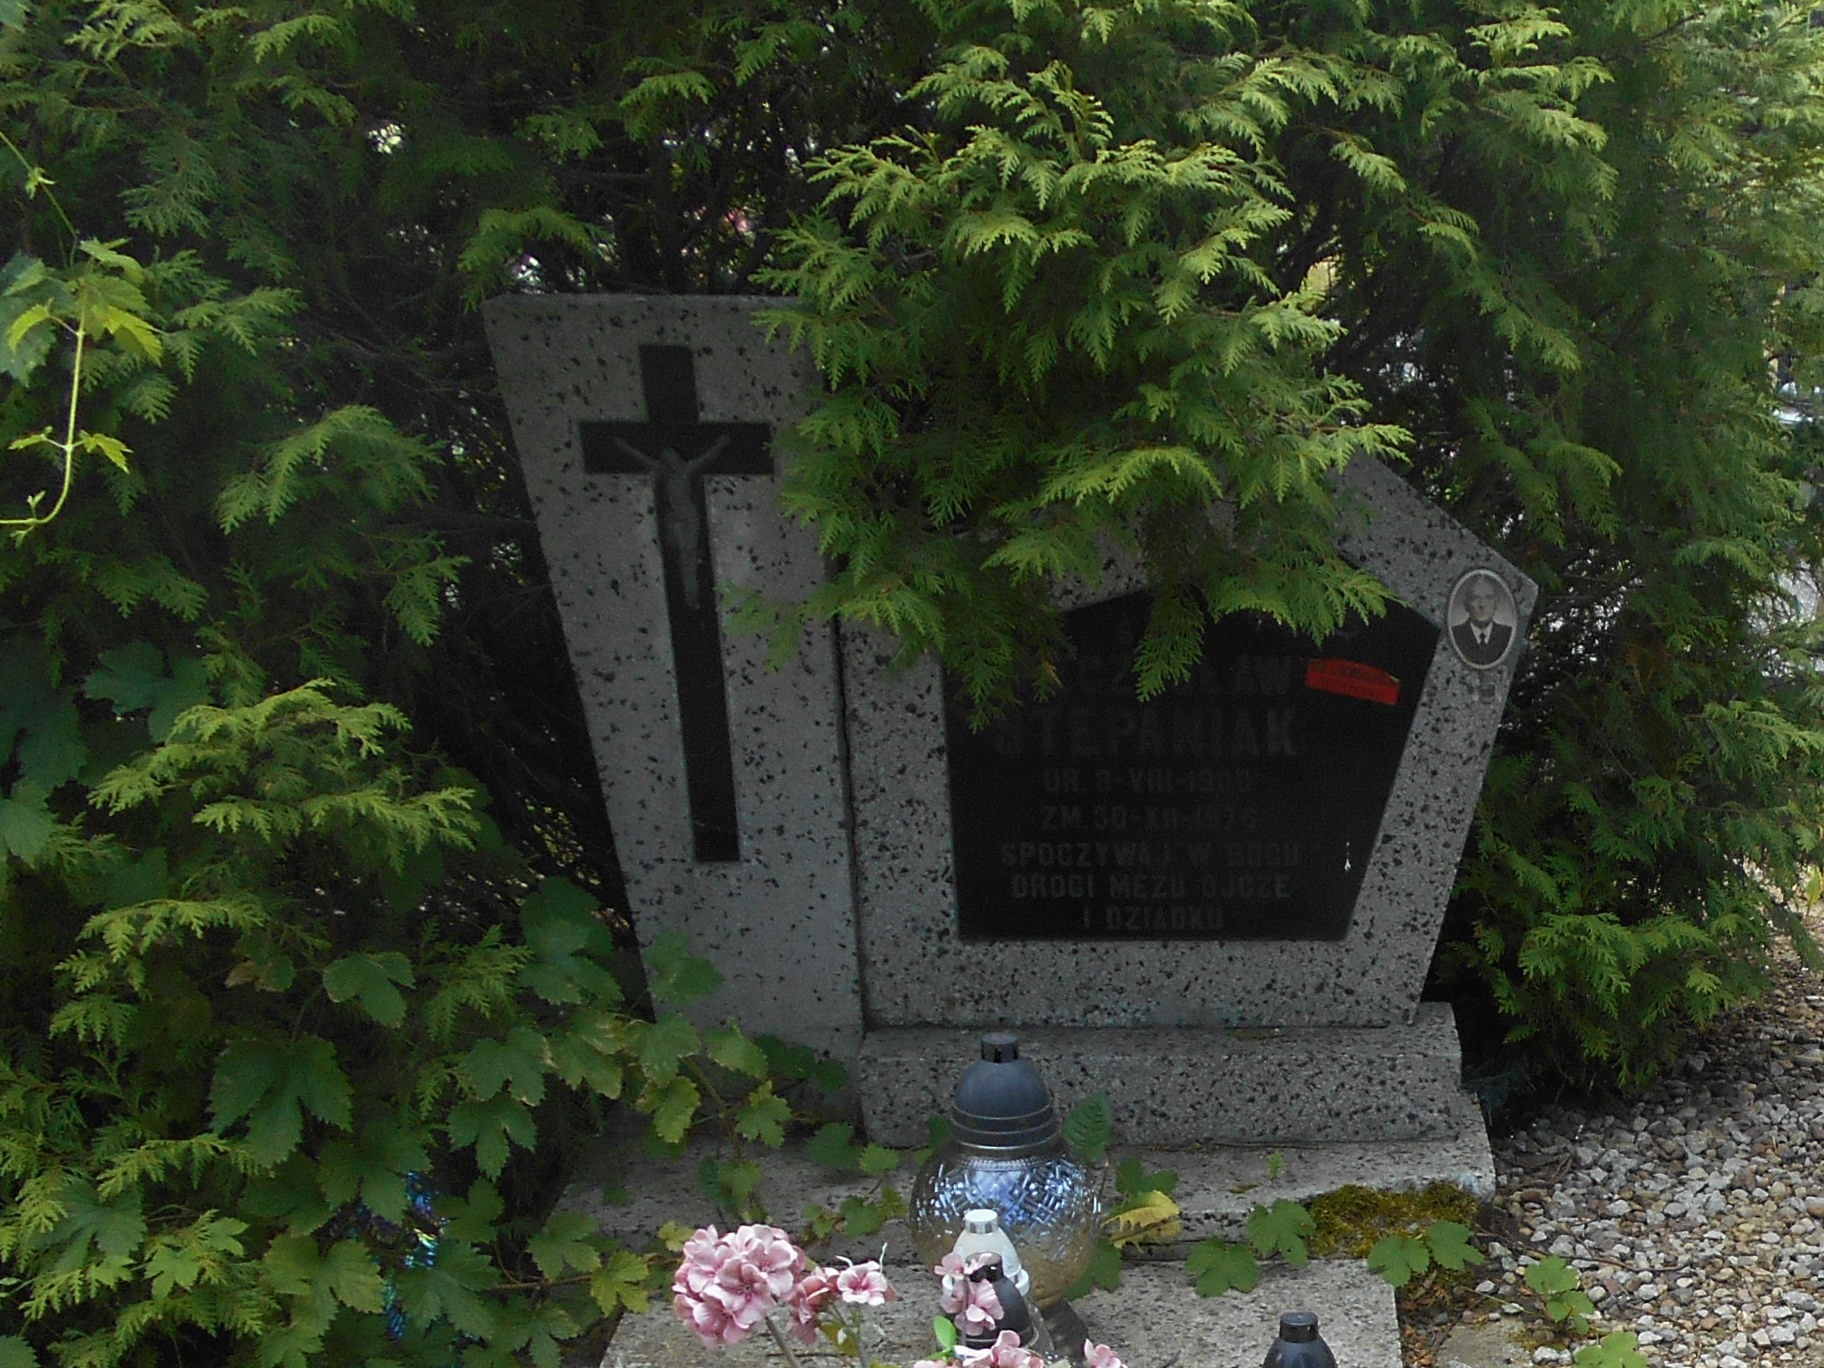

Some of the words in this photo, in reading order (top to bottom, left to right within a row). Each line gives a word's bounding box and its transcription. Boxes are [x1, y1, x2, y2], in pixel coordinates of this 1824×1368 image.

[993, 706, 1297, 757] STEPANIAK
[1042, 768, 1087, 794] UR.
[1041, 804, 1088, 831] ZM.
[1000, 842, 1171, 867] SPOCZYWAJ
[1187, 842, 1211, 867] W
[1226, 841, 1301, 868] BOGU
[1010, 873, 1095, 899] DROGI
[1202, 873, 1292, 899] OJCZE
[1082, 905, 1092, 931] I
[1105, 905, 1224, 931] DZIADKU
